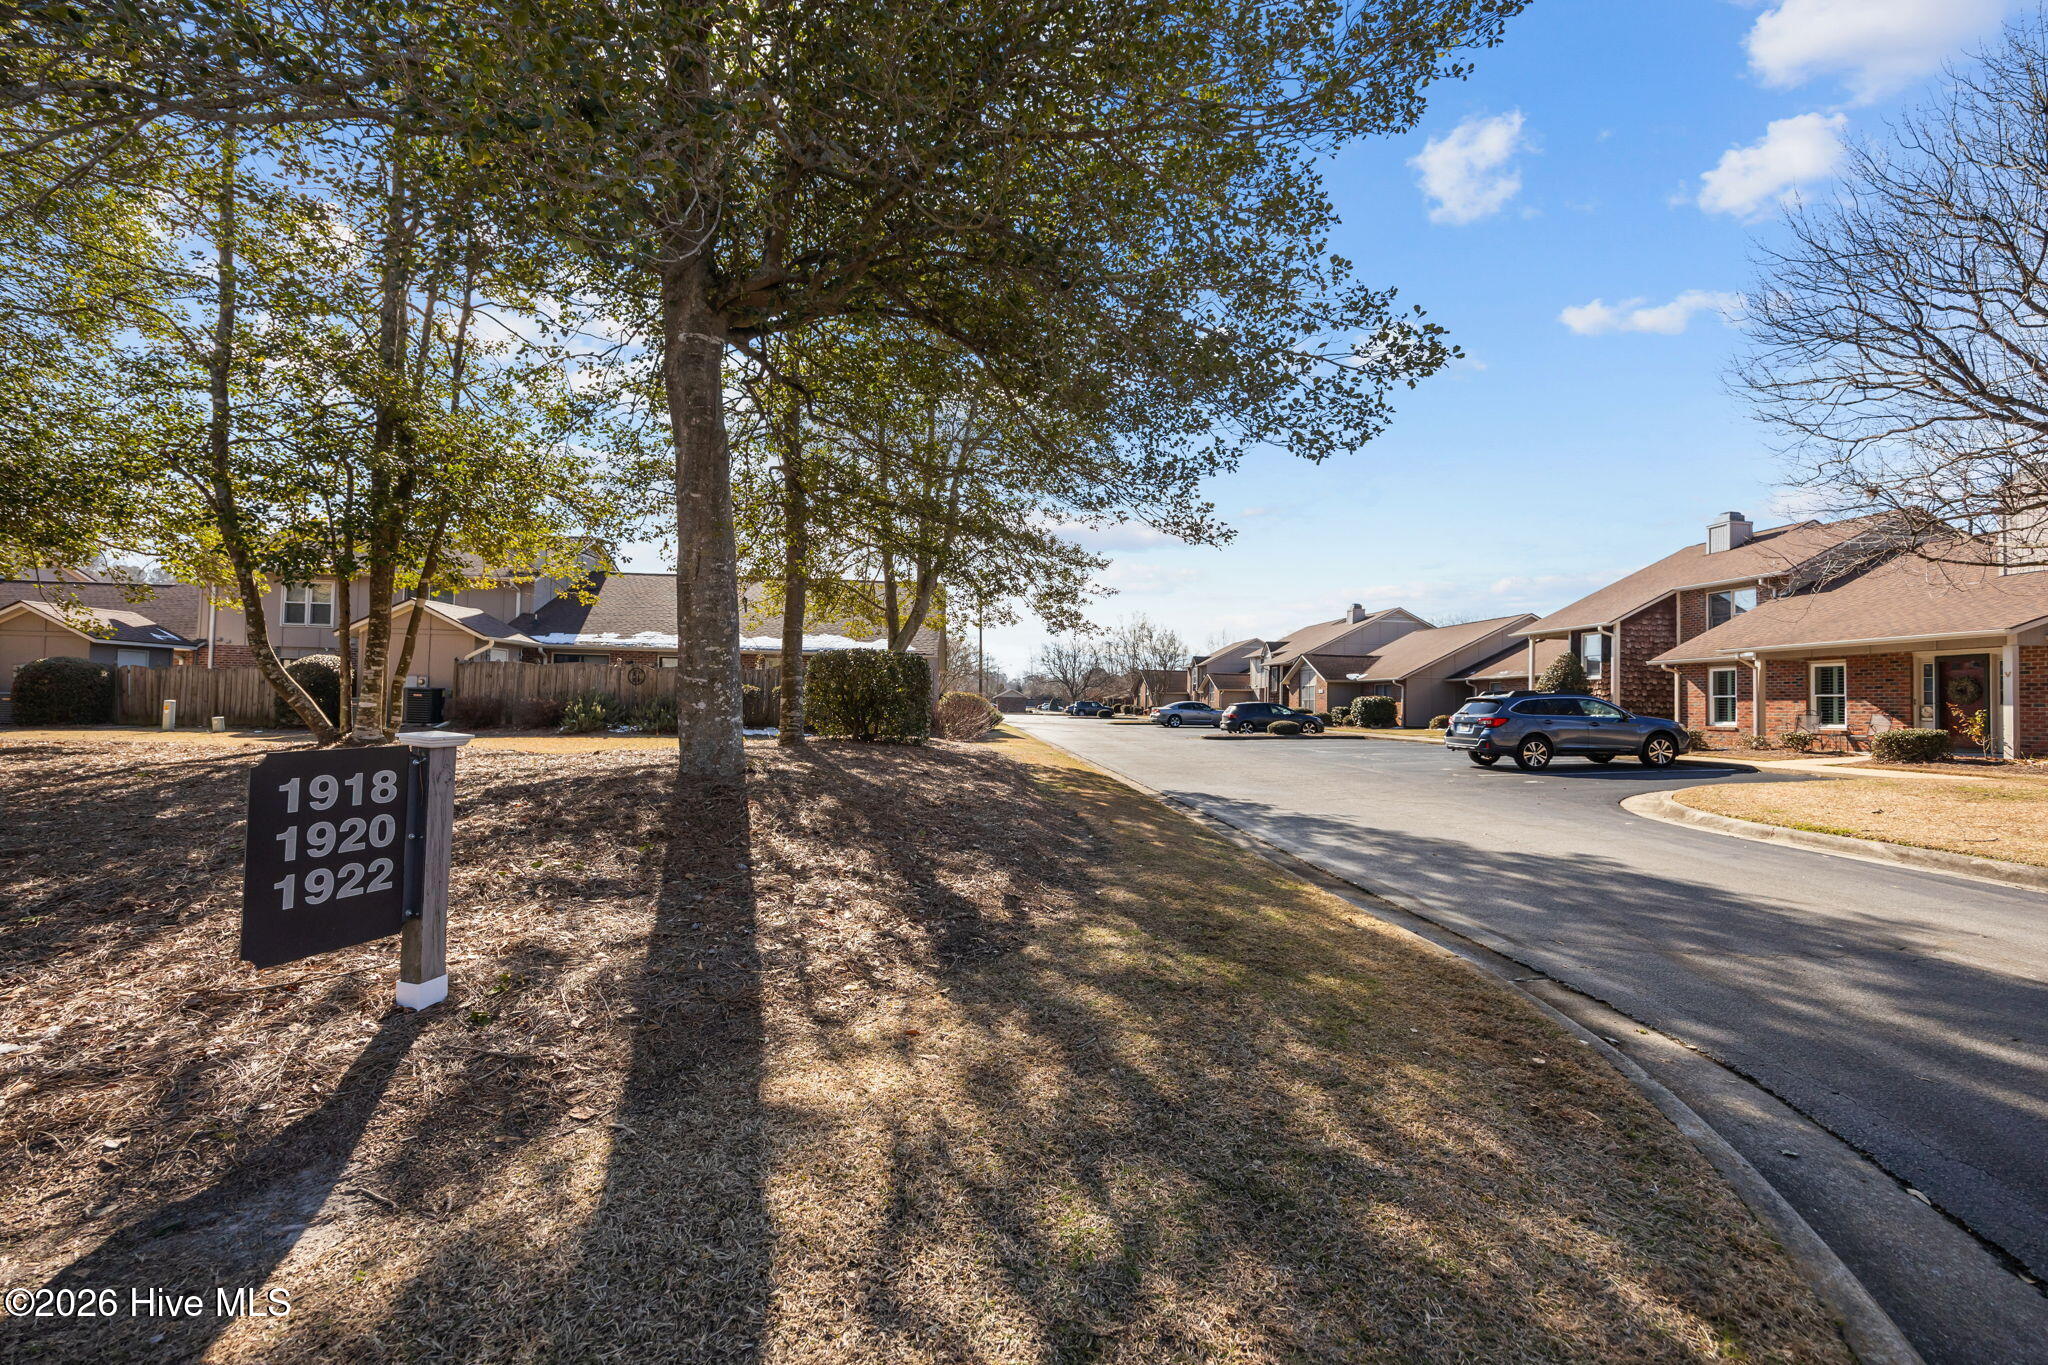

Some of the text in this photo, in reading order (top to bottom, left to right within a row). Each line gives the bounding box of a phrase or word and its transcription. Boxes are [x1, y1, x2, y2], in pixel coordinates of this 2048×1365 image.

[278, 769, 398, 814] 1918
[275, 814, 396, 862] 1920
[273, 857, 394, 911] 1922
